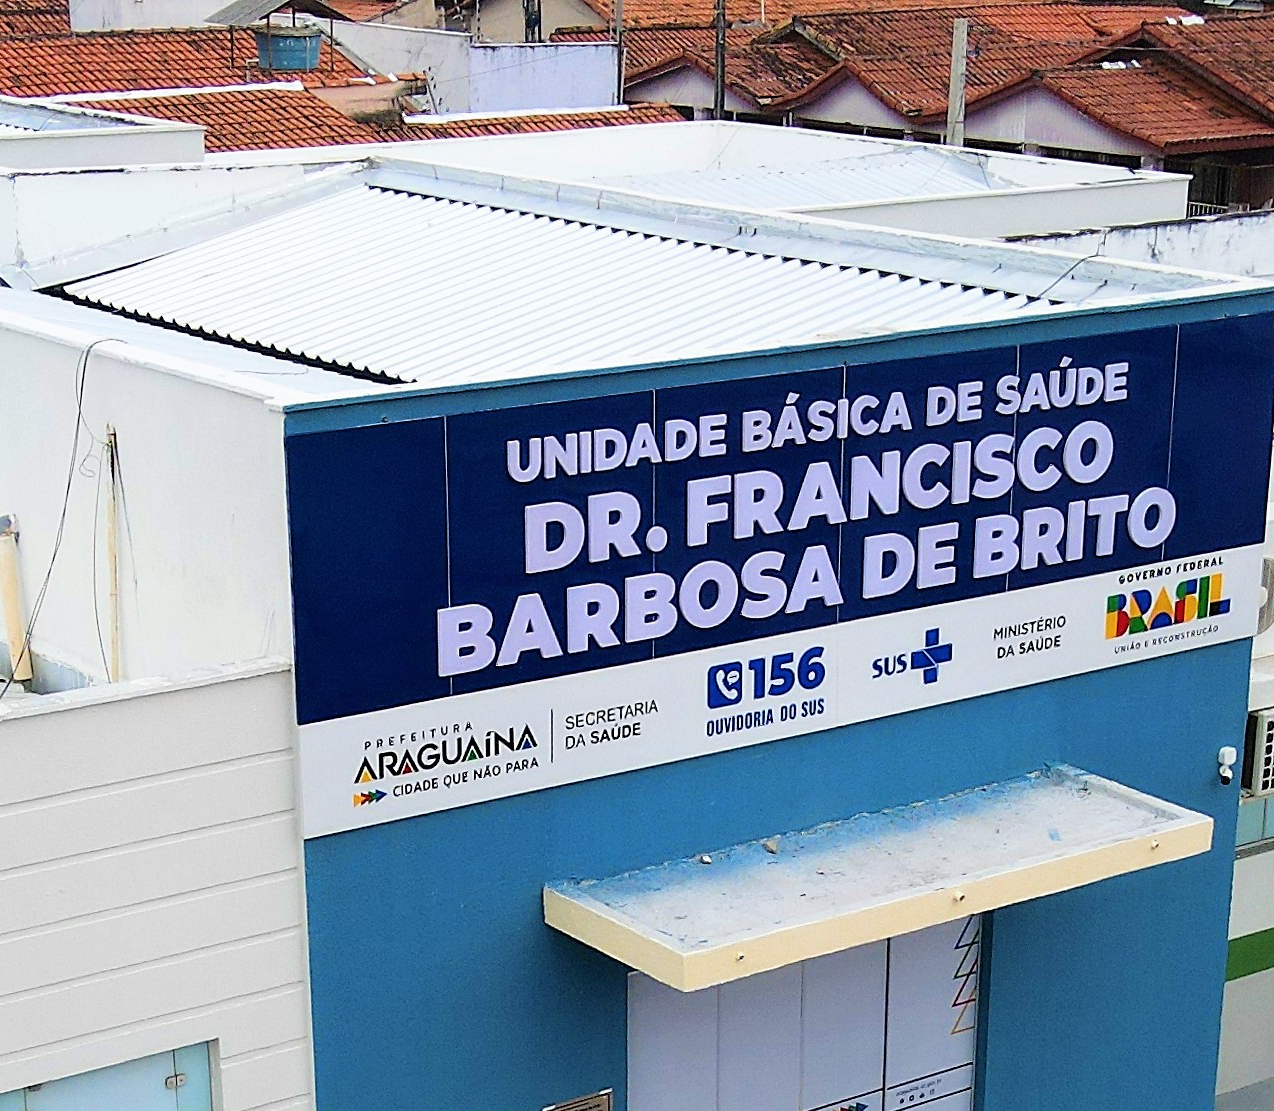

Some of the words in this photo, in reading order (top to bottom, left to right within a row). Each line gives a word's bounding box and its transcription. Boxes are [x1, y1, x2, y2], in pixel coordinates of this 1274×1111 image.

[507, 414, 727, 482] UNIDADE
[741, 392, 912, 452] BÁSICA
[926, 381, 983, 427] DE
[995, 356, 1129, 415] SAÚDE
[525, 491, 668, 574] DR.
[687, 420, 1114, 547] FRANCISCO
[437, 544, 844, 677] BARBOSA
[862, 522, 959, 599] DE
[973, 487, 1176, 578] BRITO
[1118, 566, 1172, 585] GOVERNO
[1176, 556, 1225, 575] FEDERAL
[1104, 572, 1232, 640] BRASIL
[993, 615, 1067, 640] MINISTÉRIO
[1114, 640, 1141, 655] UNIÃO
[1152, 624, 1219, 646] RECONSTRUÇÃO
[997, 643, 1015, 660] DA
[1019, 634, 1061, 655] SAÚDE
[748, 646, 826, 700] 156
[872, 653, 908, 680] SUS
[565, 699, 659, 731] SECRETARIA
[706, 707, 774, 738] OUVIDORIA
[780, 704, 797, 722] DO
[801, 698, 825, 718] SUS
[364, 721, 473, 750] PREFEITURA
[565, 733, 586, 750] DA
[590, 722, 641, 745] SAÚDE
[393, 777, 439, 797] CIDADE
[443, 771, 469, 788] QUE
[473, 764, 501, 780] NÃO
[505, 757, 540, 774] PARA
